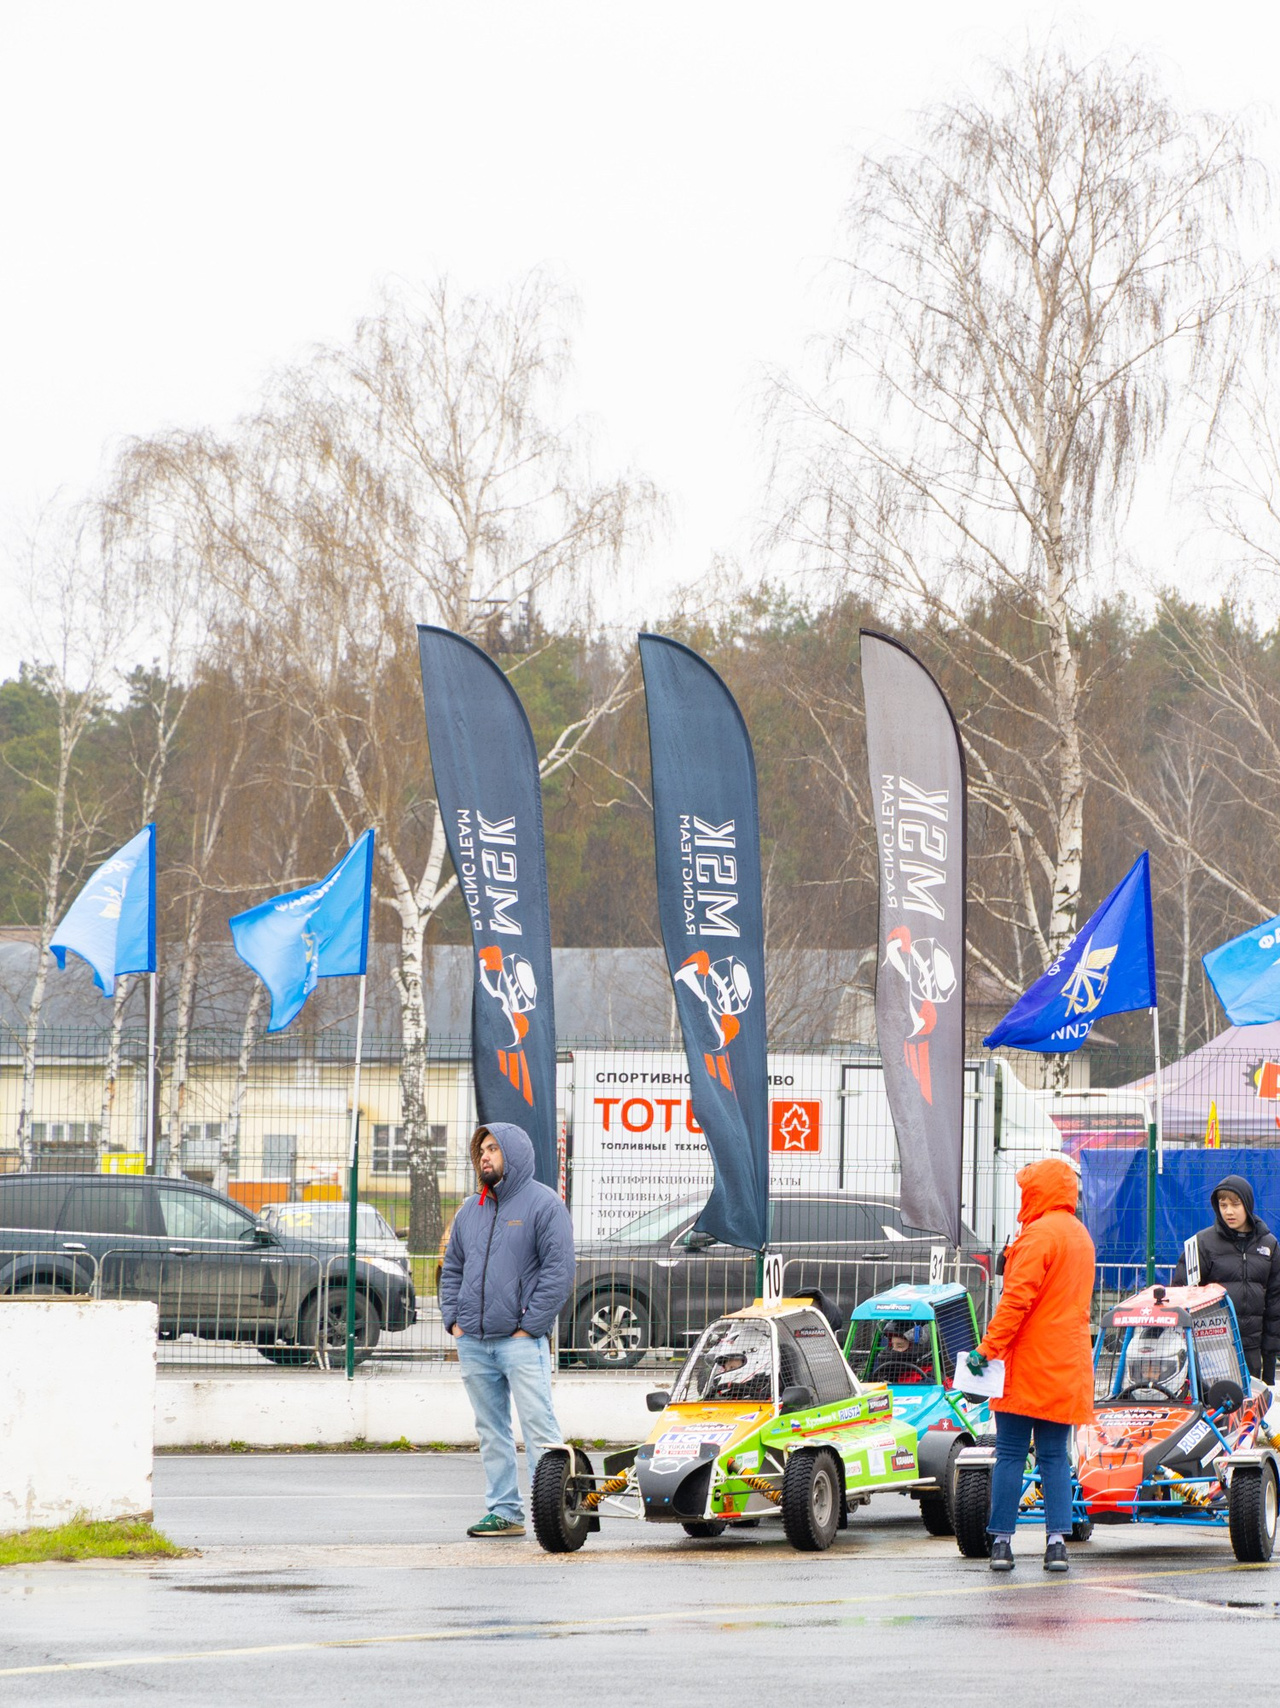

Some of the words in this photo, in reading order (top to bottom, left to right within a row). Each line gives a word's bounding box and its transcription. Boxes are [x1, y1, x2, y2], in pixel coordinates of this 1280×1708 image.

[596, 1072, 690, 1084] СПОРТИВНО
[601, 1142, 667, 1151] ТОПЛИВНЫЕ
[675, 1143, 708, 1151] ТЕХНО
[598, 1175, 714, 1185] АНТИФРИКЦИОНН
[598, 1192, 671, 1202] ТОПЛИВНАЯ
[931, 1254, 944, 1280] 31
[765, 1258, 781, 1299] 10
[1208, 1317, 1228, 1326] ADV
[1200, 1328, 1225, 1336] RACING
[840, 1405, 861, 1421] RUSTA
[1181, 1421, 1210, 1452] RUSTA
